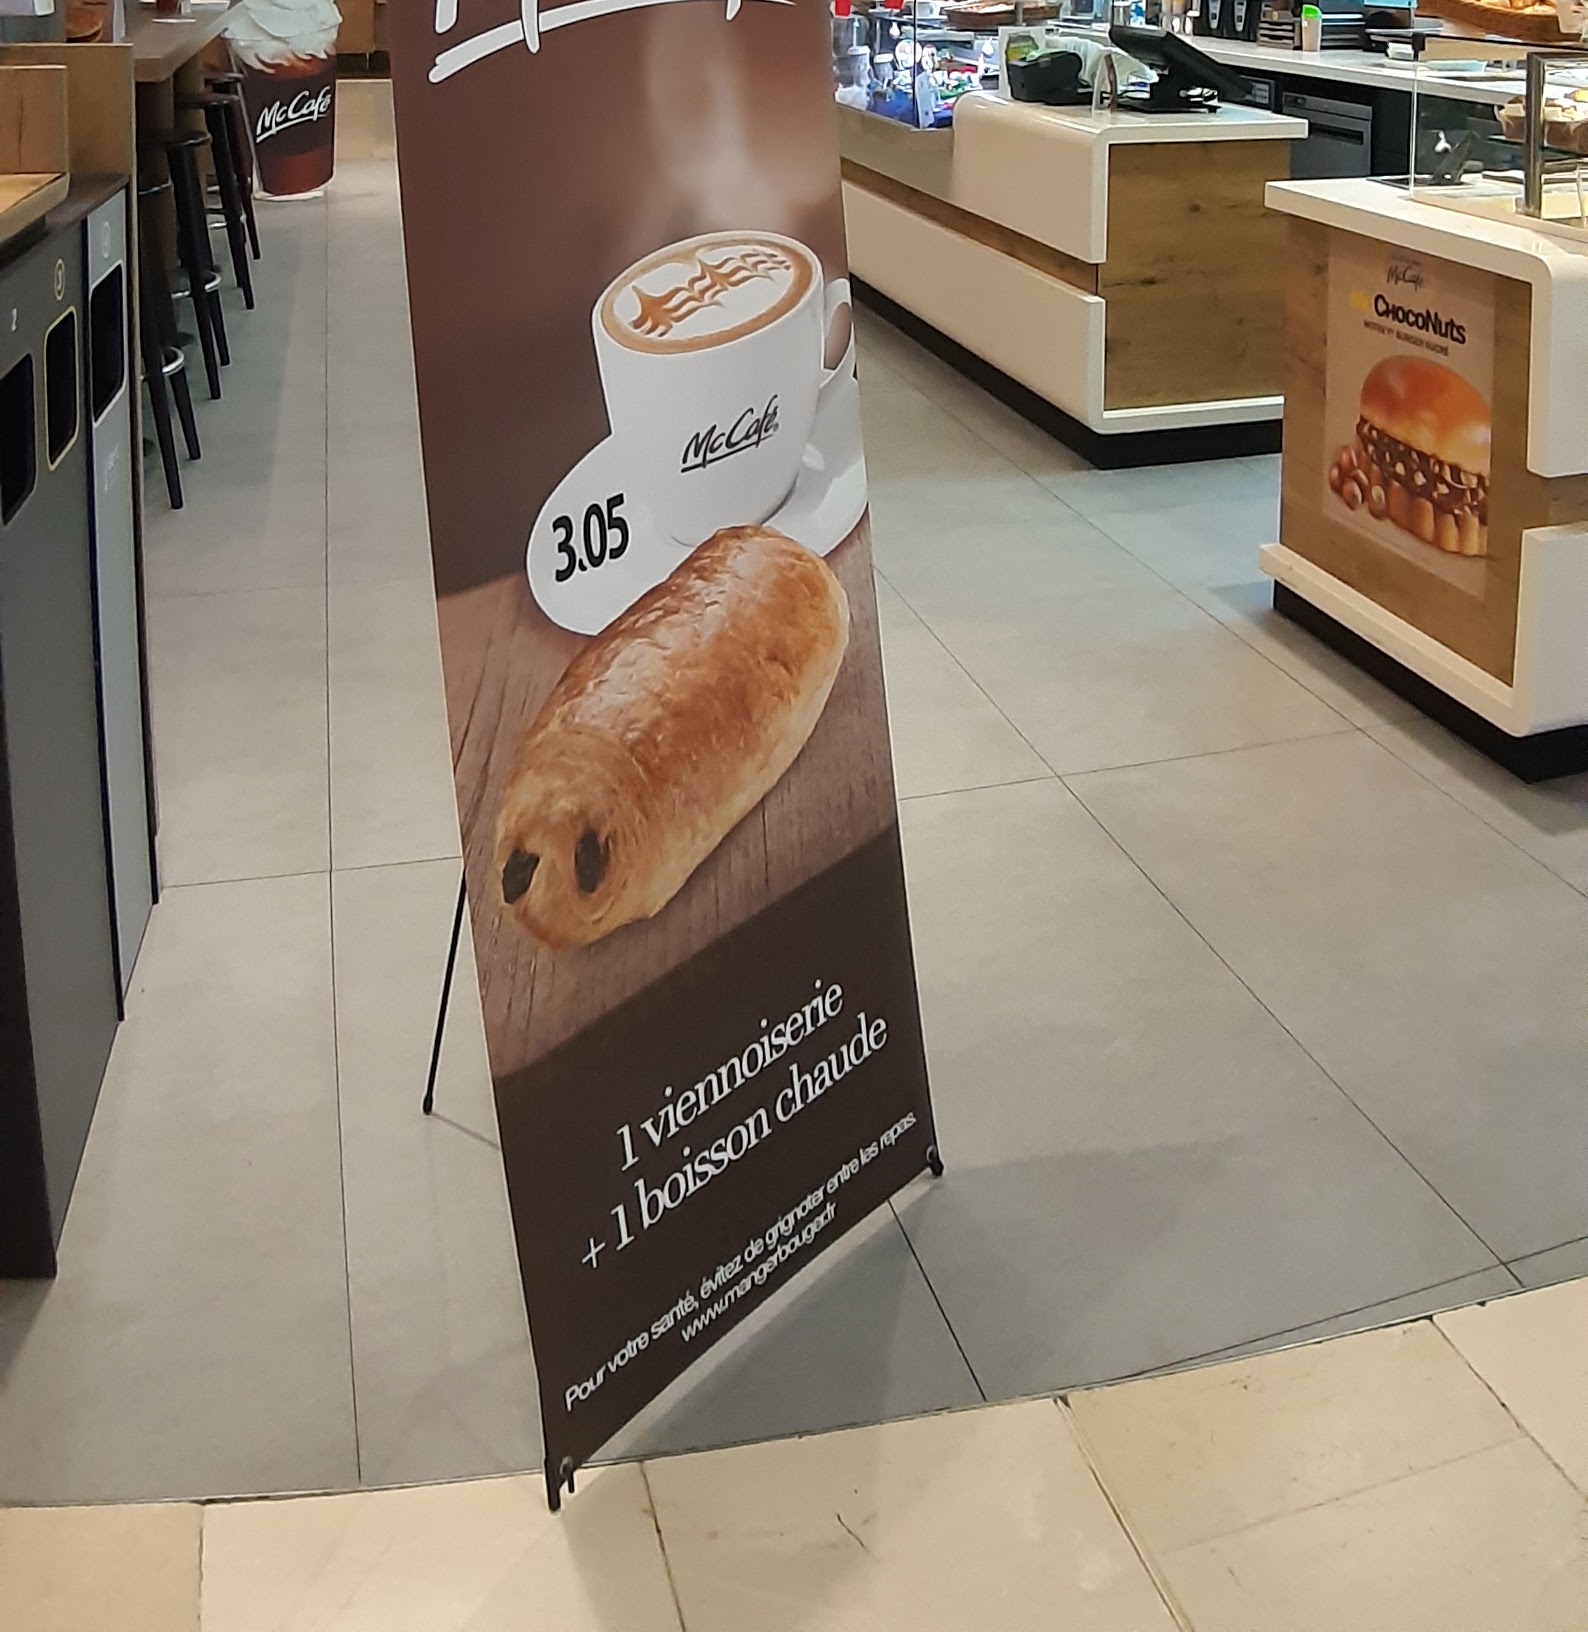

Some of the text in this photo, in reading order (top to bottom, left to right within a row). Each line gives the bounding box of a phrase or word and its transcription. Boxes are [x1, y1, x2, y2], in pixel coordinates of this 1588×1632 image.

[256, 86, 332, 141] McCafé
[681, 394, 779, 471] McCafé
[552, 493, 629, 582] 3.05
[582, 1012, 888, 1268] + 1 boisson chaude
[616, 979, 843, 1171] 1 viennoiserie
[565, 1365, 606, 1412] Pour
[607, 1332, 649, 1372] votre
[651, 1289, 699, 1339] santé,
[700, 1254, 744, 1299] évitez
[744, 1235, 765, 1263] de
[765, 1184, 826, 1250] grignoter
[826, 1156, 860, 1194] entre
[859, 1141, 880, 1166] les
[681, 1201, 837, 1342] www.mangerbouger.fr
